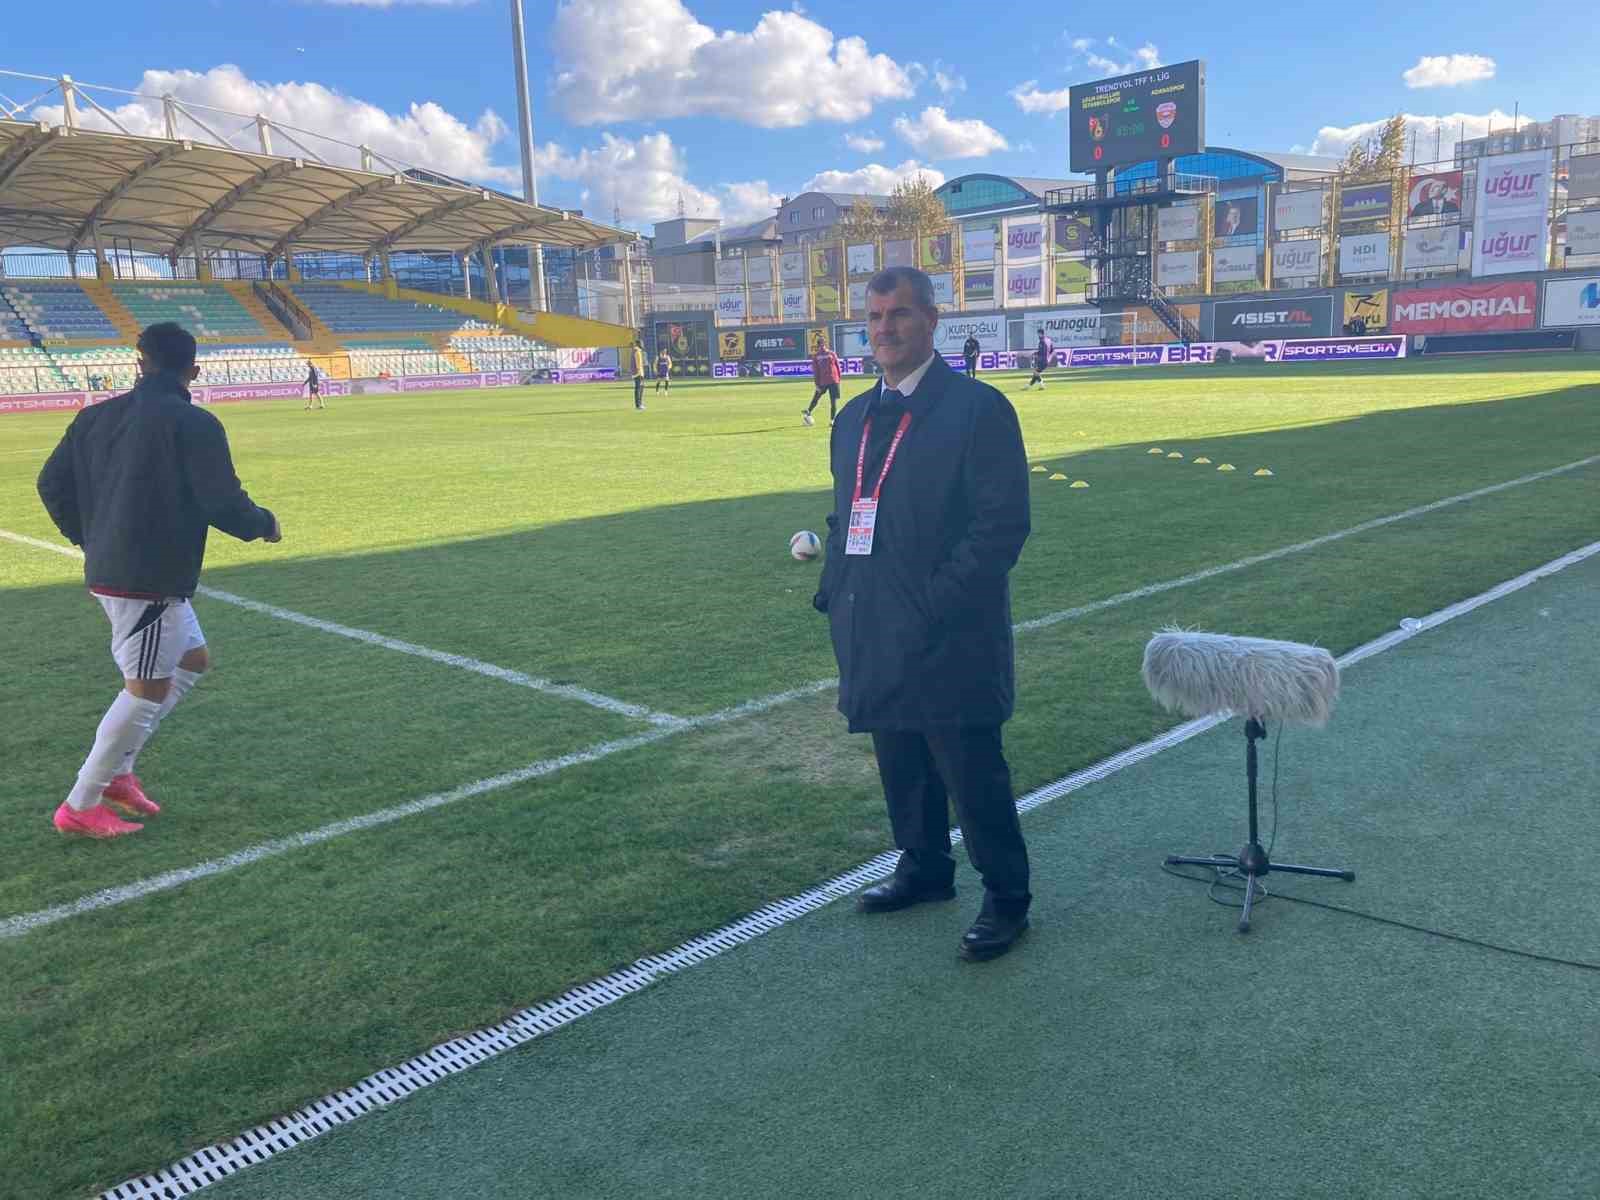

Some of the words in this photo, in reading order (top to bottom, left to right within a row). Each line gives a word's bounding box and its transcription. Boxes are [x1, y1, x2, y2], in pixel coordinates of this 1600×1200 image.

[1095, 81, 1133, 94] TRENDYOL
[1134, 77, 1148, 87] TFF
[1485, 169, 1542, 197] uğur
[1353, 244, 1375, 255] HDI
[1481, 232, 1536, 257] uğur
[1395, 296, 1531, 321] MEMORIAL
